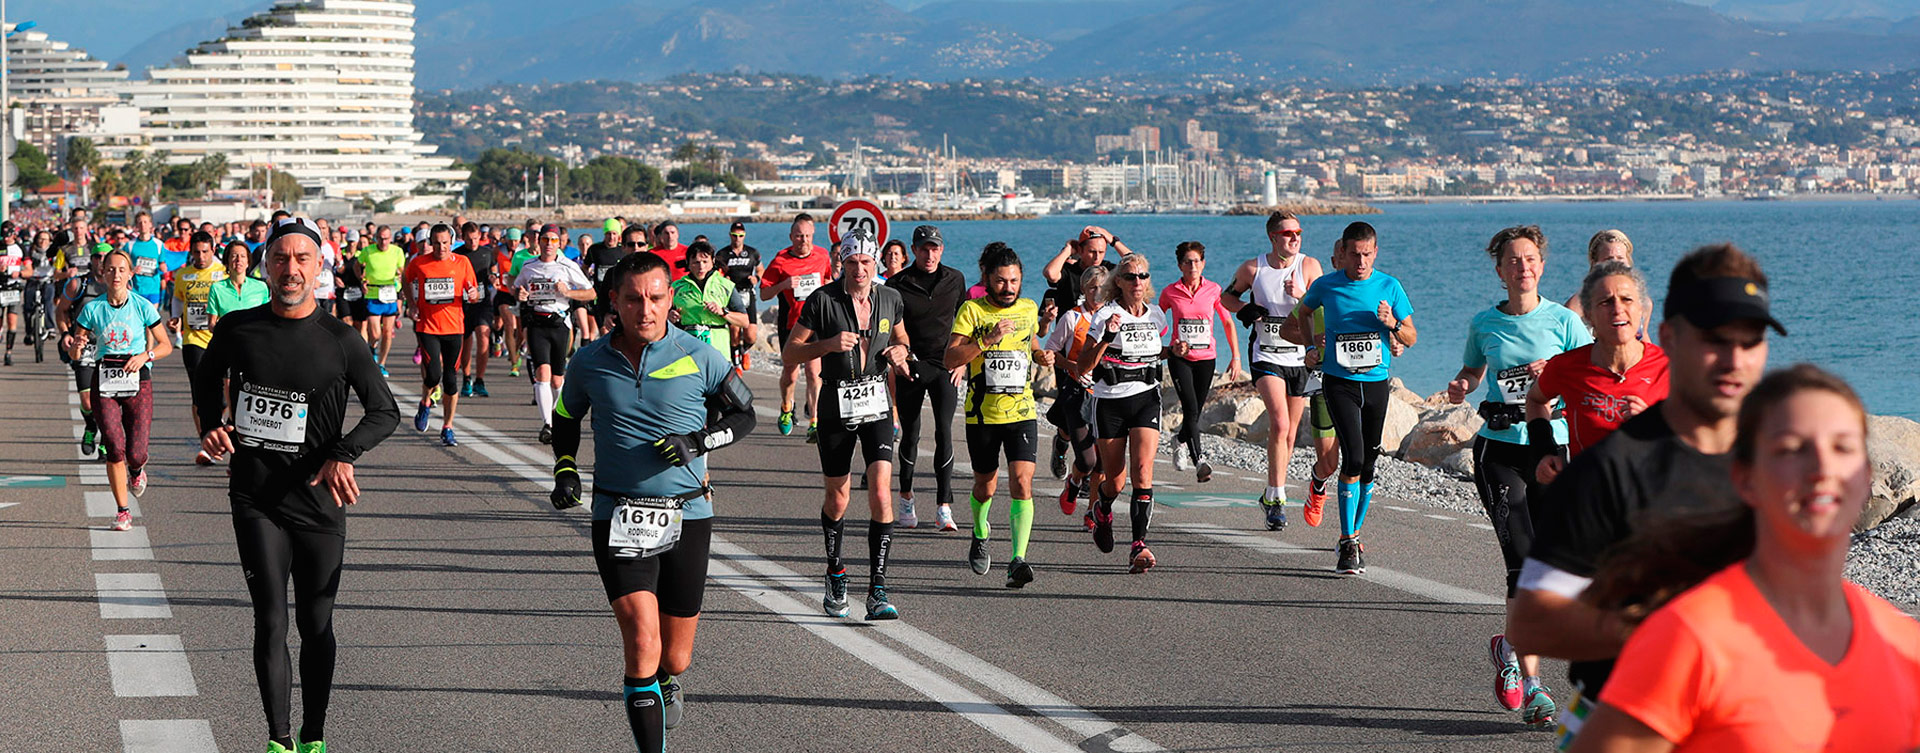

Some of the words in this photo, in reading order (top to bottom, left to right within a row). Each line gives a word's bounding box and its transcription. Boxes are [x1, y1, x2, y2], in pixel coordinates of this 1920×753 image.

[842, 217, 876, 235] 70
[800, 279, 815, 287] 644
[1181, 325, 1204, 333] 3310
[1264, 323, 1282, 333] 36
[1125, 331, 1153, 342] 2995
[1341, 341, 1373, 352] 1860
[989, 360, 1021, 371] 4079
[1505, 377, 1531, 393] 27
[291, 391, 306, 403] 06
[843, 385, 875, 400] 4241
[244, 395, 293, 420] 1976
[250, 416, 282, 430] THOMEROT
[667, 499, 680, 509] 06
[619, 508, 669, 528] 1610
[627, 528, 659, 539] RODRIGUE
